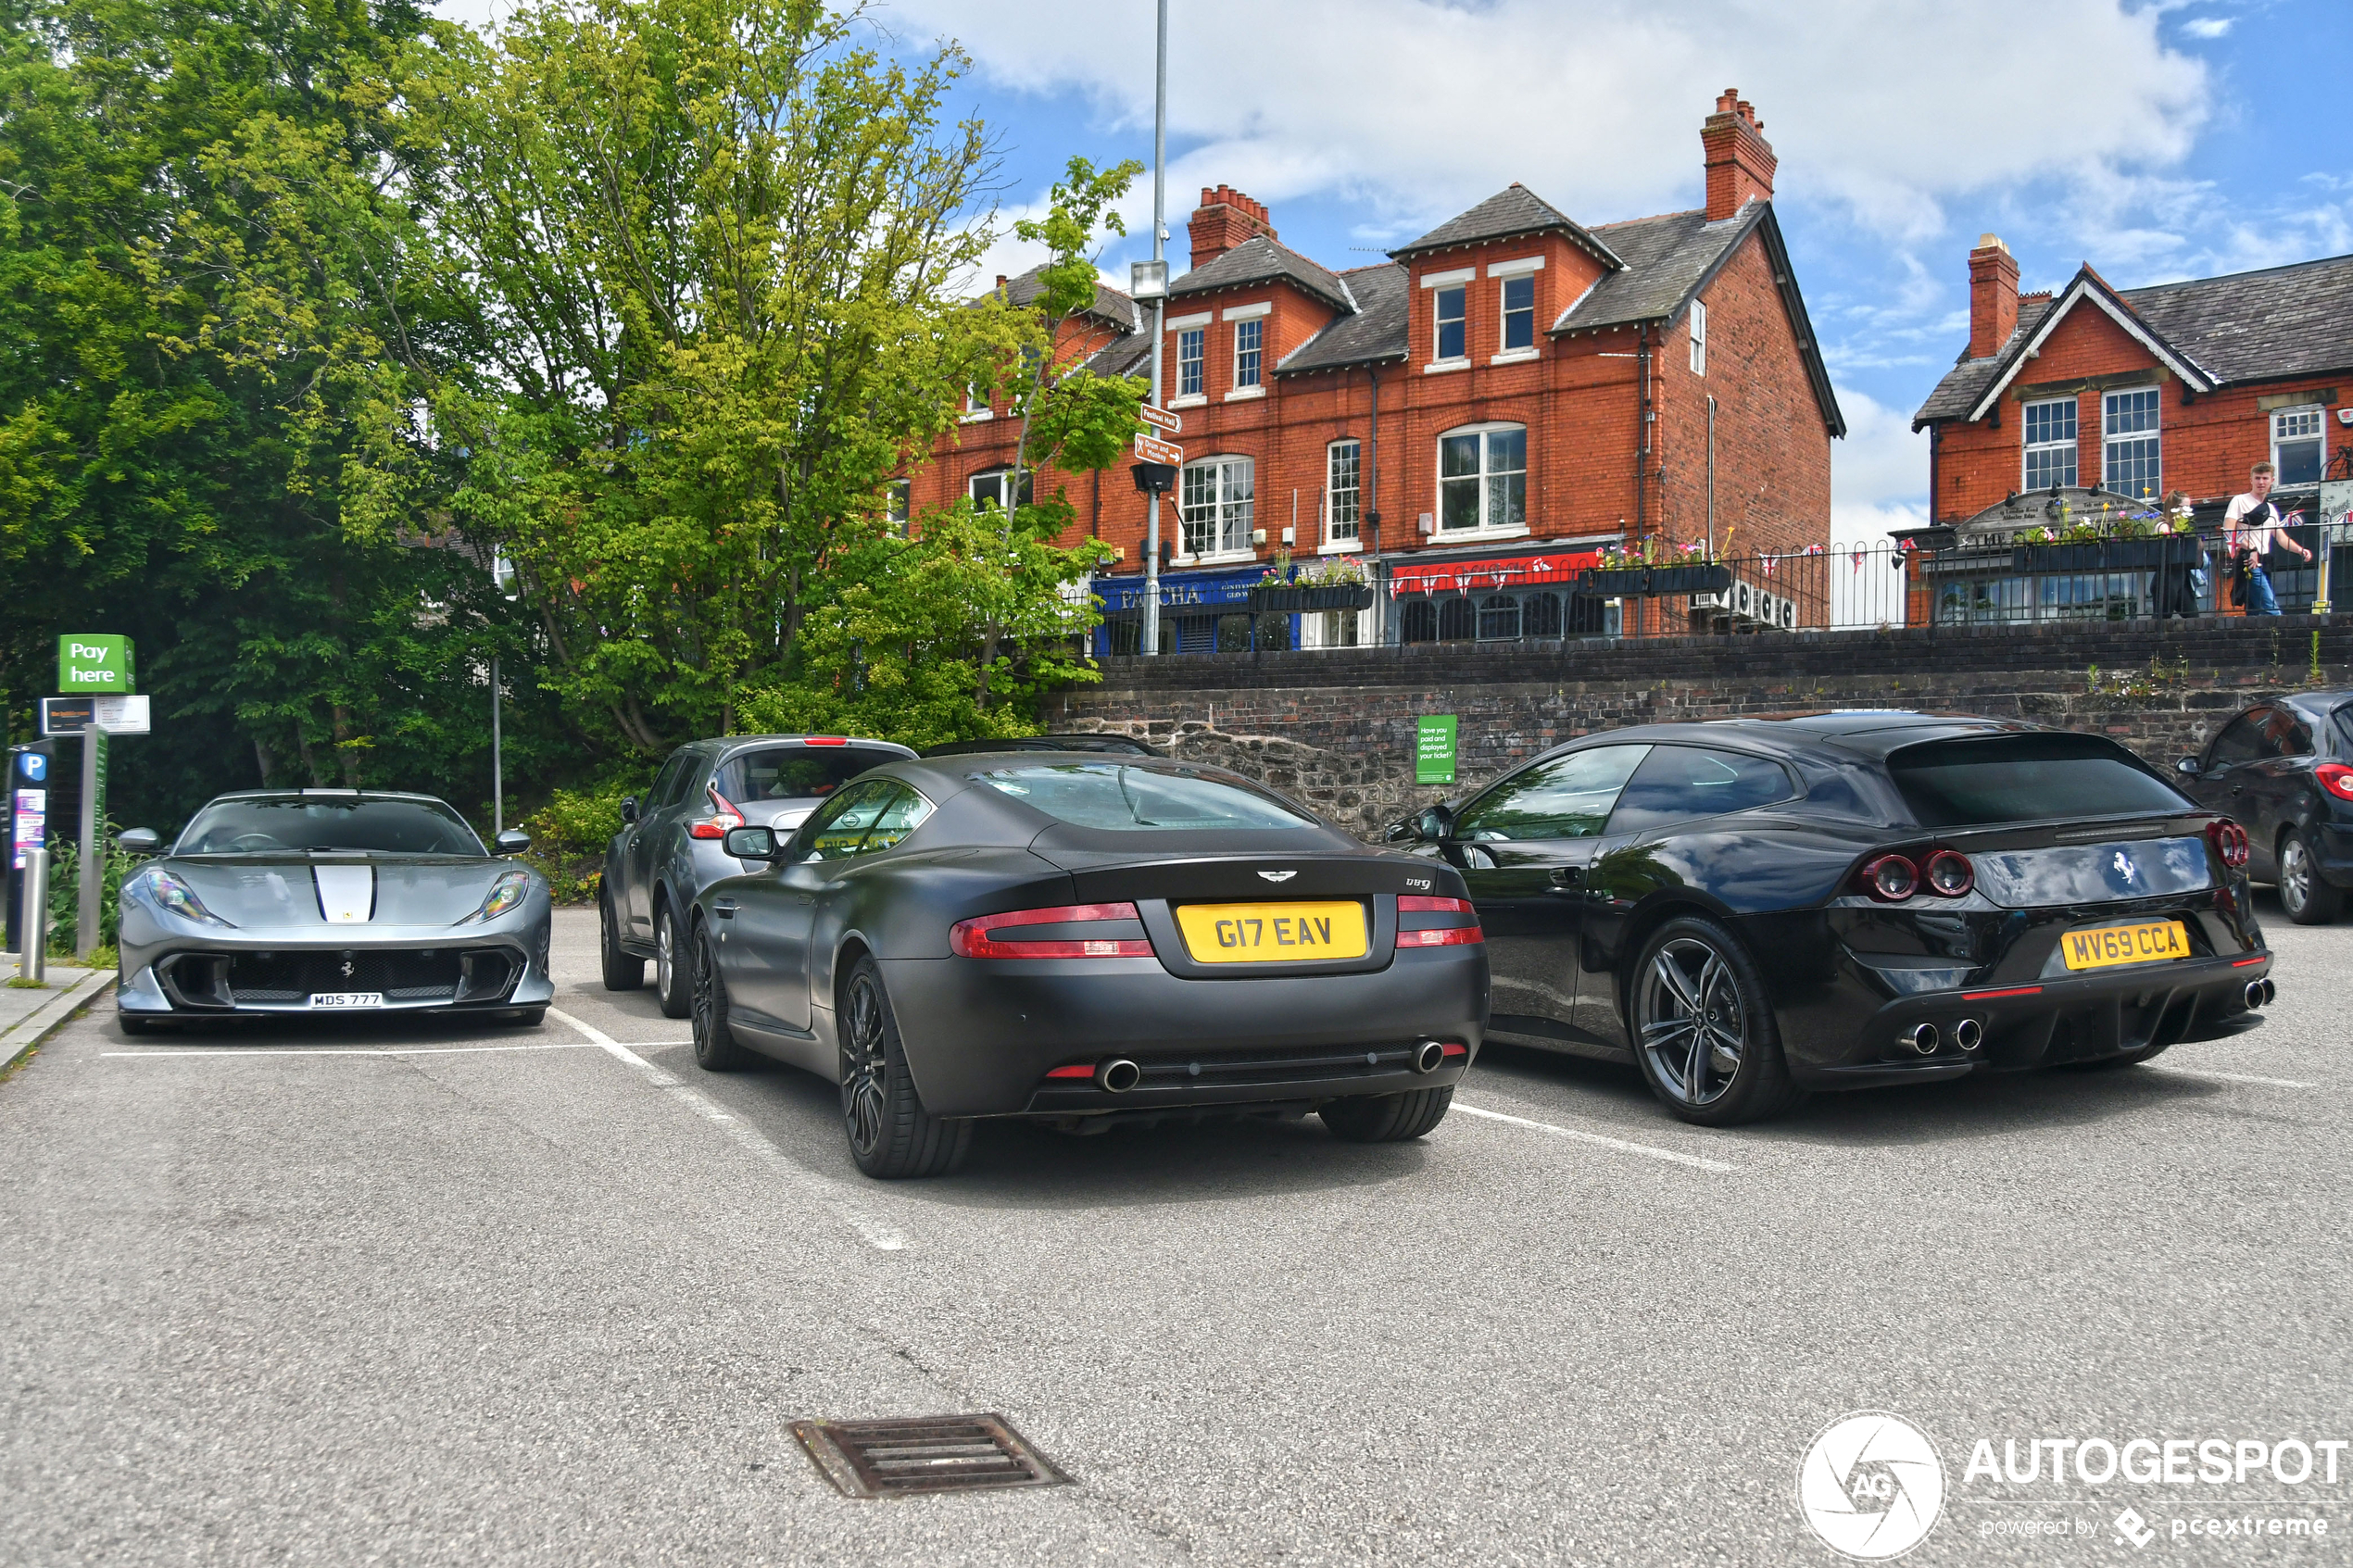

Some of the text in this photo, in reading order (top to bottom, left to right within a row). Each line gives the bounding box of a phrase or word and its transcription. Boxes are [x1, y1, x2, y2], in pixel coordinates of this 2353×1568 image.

[1143, 408, 1176, 426] Festival Hall
[1145, 440, 1169, 454] Drum and
[1147, 449, 1166, 462] Monkey
[70, 643, 108, 663] Pay
[71, 666, 115, 683] here
[1420, 744, 1447, 752] displayed
[28, 756, 43, 775] P
[1406, 878, 1431, 890] DB9
[1215, 917, 1330, 947] G17 EAV
[2071, 925, 2180, 962] MV69 CCA
[315, 995, 379, 1005] MDS 777
